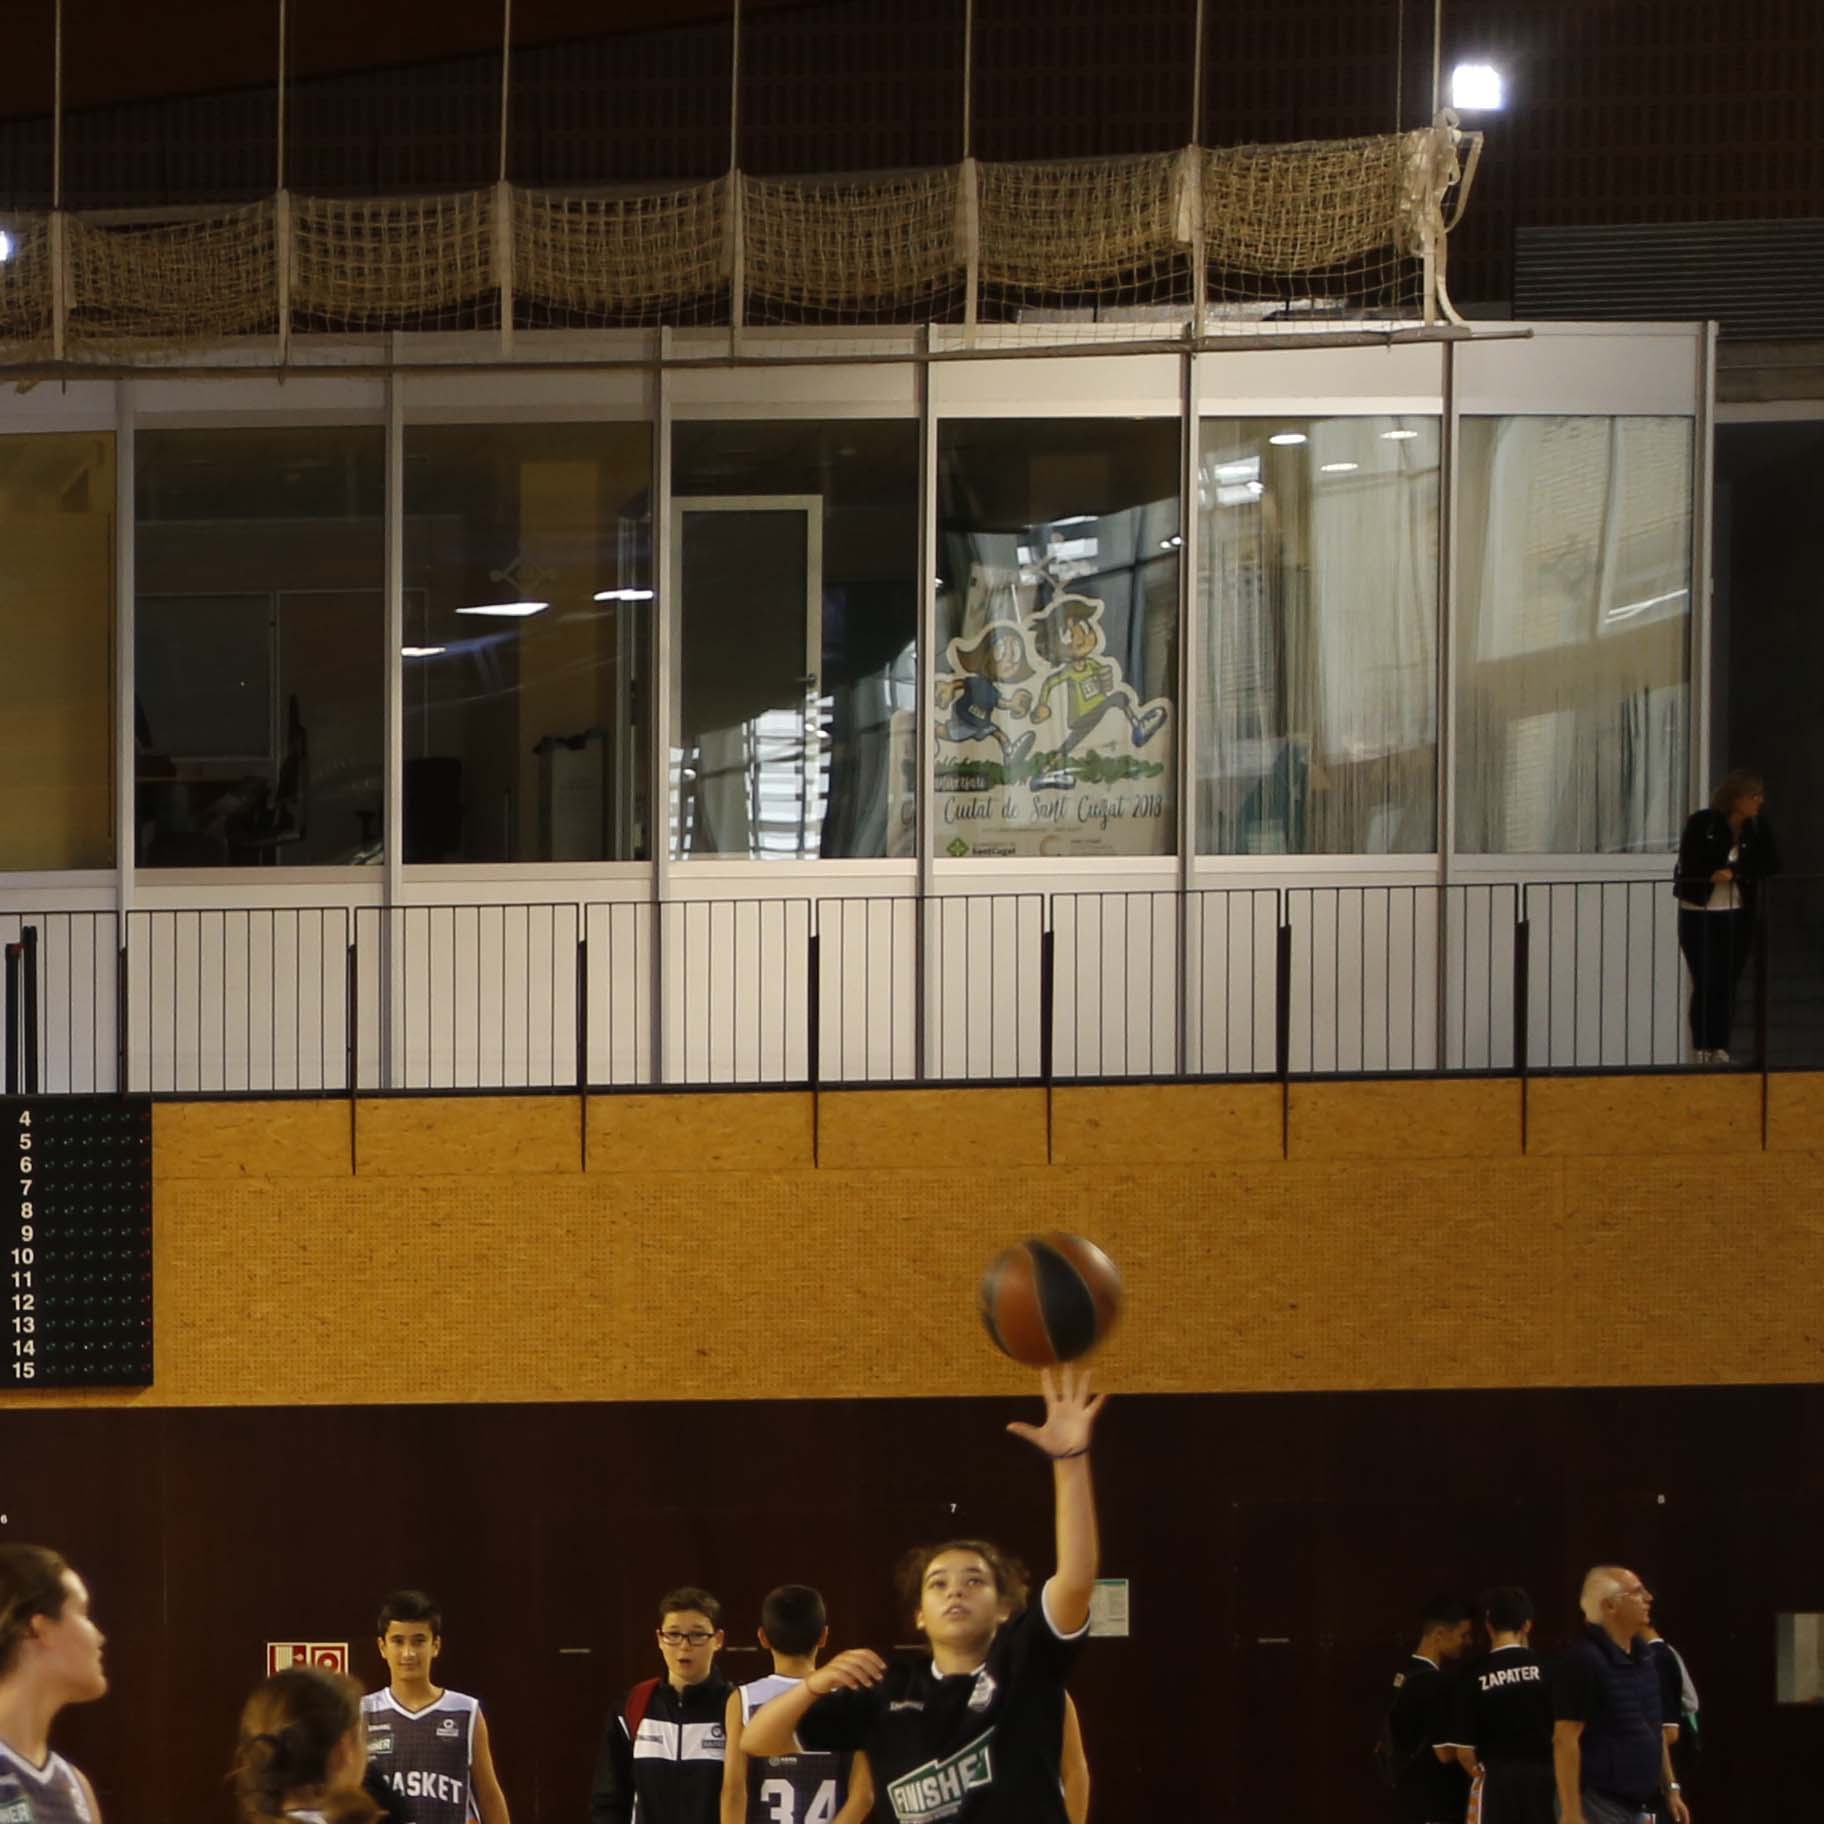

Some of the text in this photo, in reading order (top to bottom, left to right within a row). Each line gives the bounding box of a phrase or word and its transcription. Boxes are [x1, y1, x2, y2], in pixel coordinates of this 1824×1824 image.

[19, 1110, 32, 1127] 4
[19, 1133, 32, 1150] 5
[19, 1156, 33, 1173] 6
[20, 1179, 33, 1196] 7
[20, 1201, 34, 1219] 8
[21, 1225, 34, 1242] 9
[11, 1247, 34, 1265] 10
[11, 1271, 32, 1288] 11
[11, 1293, 35, 1311] 12
[12, 1316, 35, 1334] 13
[12, 1339, 36, 1357] 14
[12, 1361, 35, 1379] 15
[1478, 1665, 1541, 1691] ZAPATER
[382, 1771, 463, 1804] ASKET
